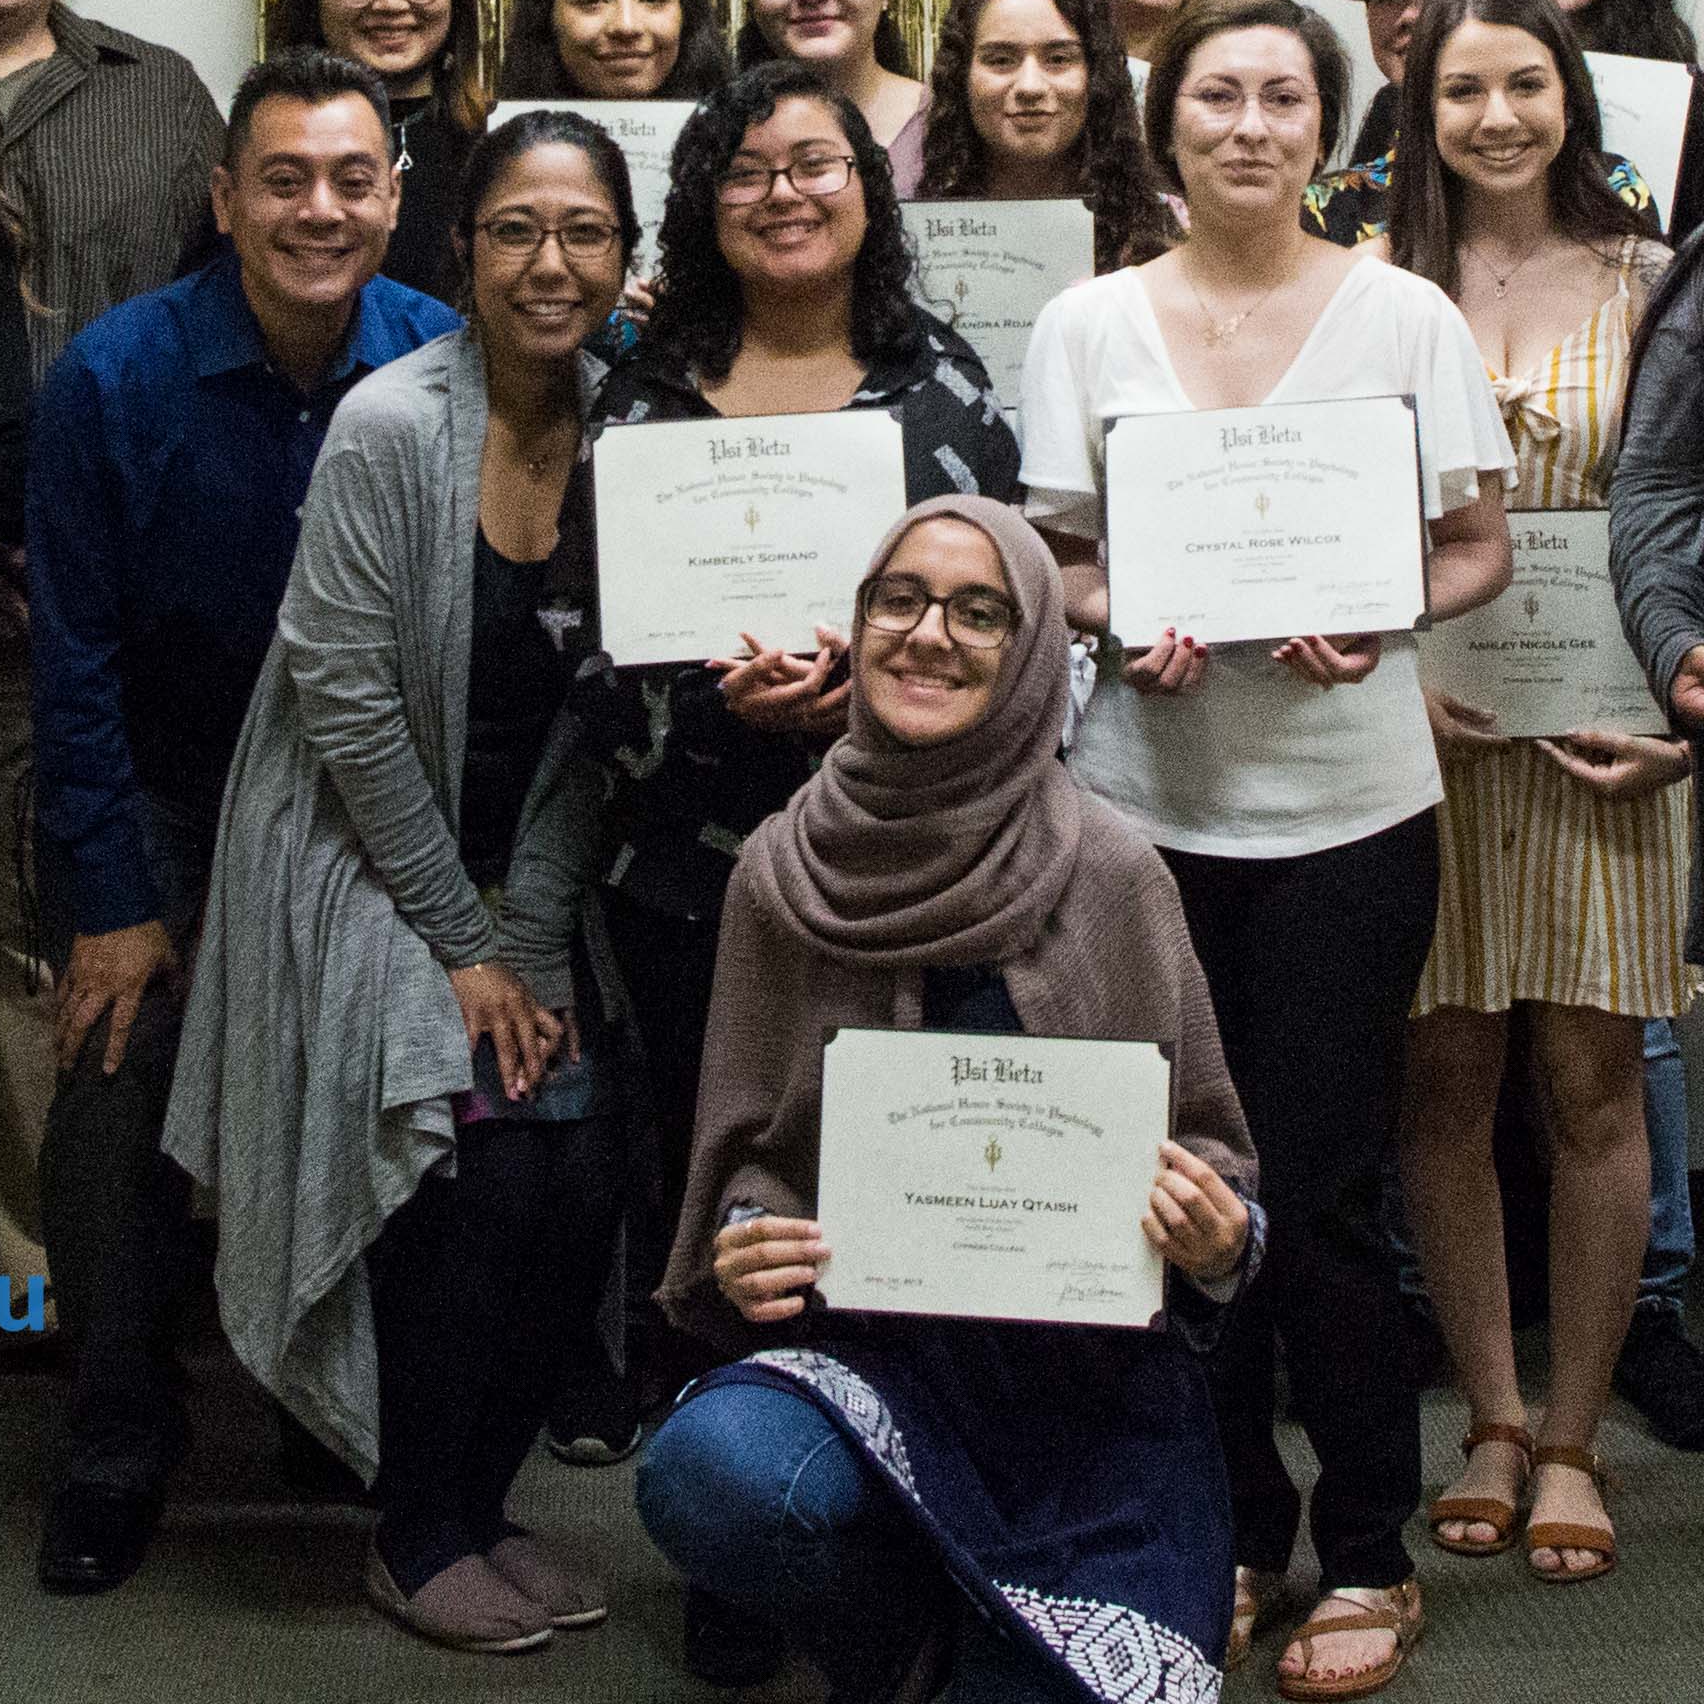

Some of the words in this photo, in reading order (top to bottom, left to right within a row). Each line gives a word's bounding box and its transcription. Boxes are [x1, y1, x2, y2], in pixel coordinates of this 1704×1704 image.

[1185, 541, 1244, 554] CRYSTAL
[1288, 534, 1341, 546] WILCOX
[688, 553, 755, 568] KIMBERLY
[758, 551, 818, 564] SORIANO
[904, 1192, 975, 1208] YASMEEN
[979, 1196, 1018, 1210] LUAY
[1022, 1198, 1078, 1213] QTAISH
